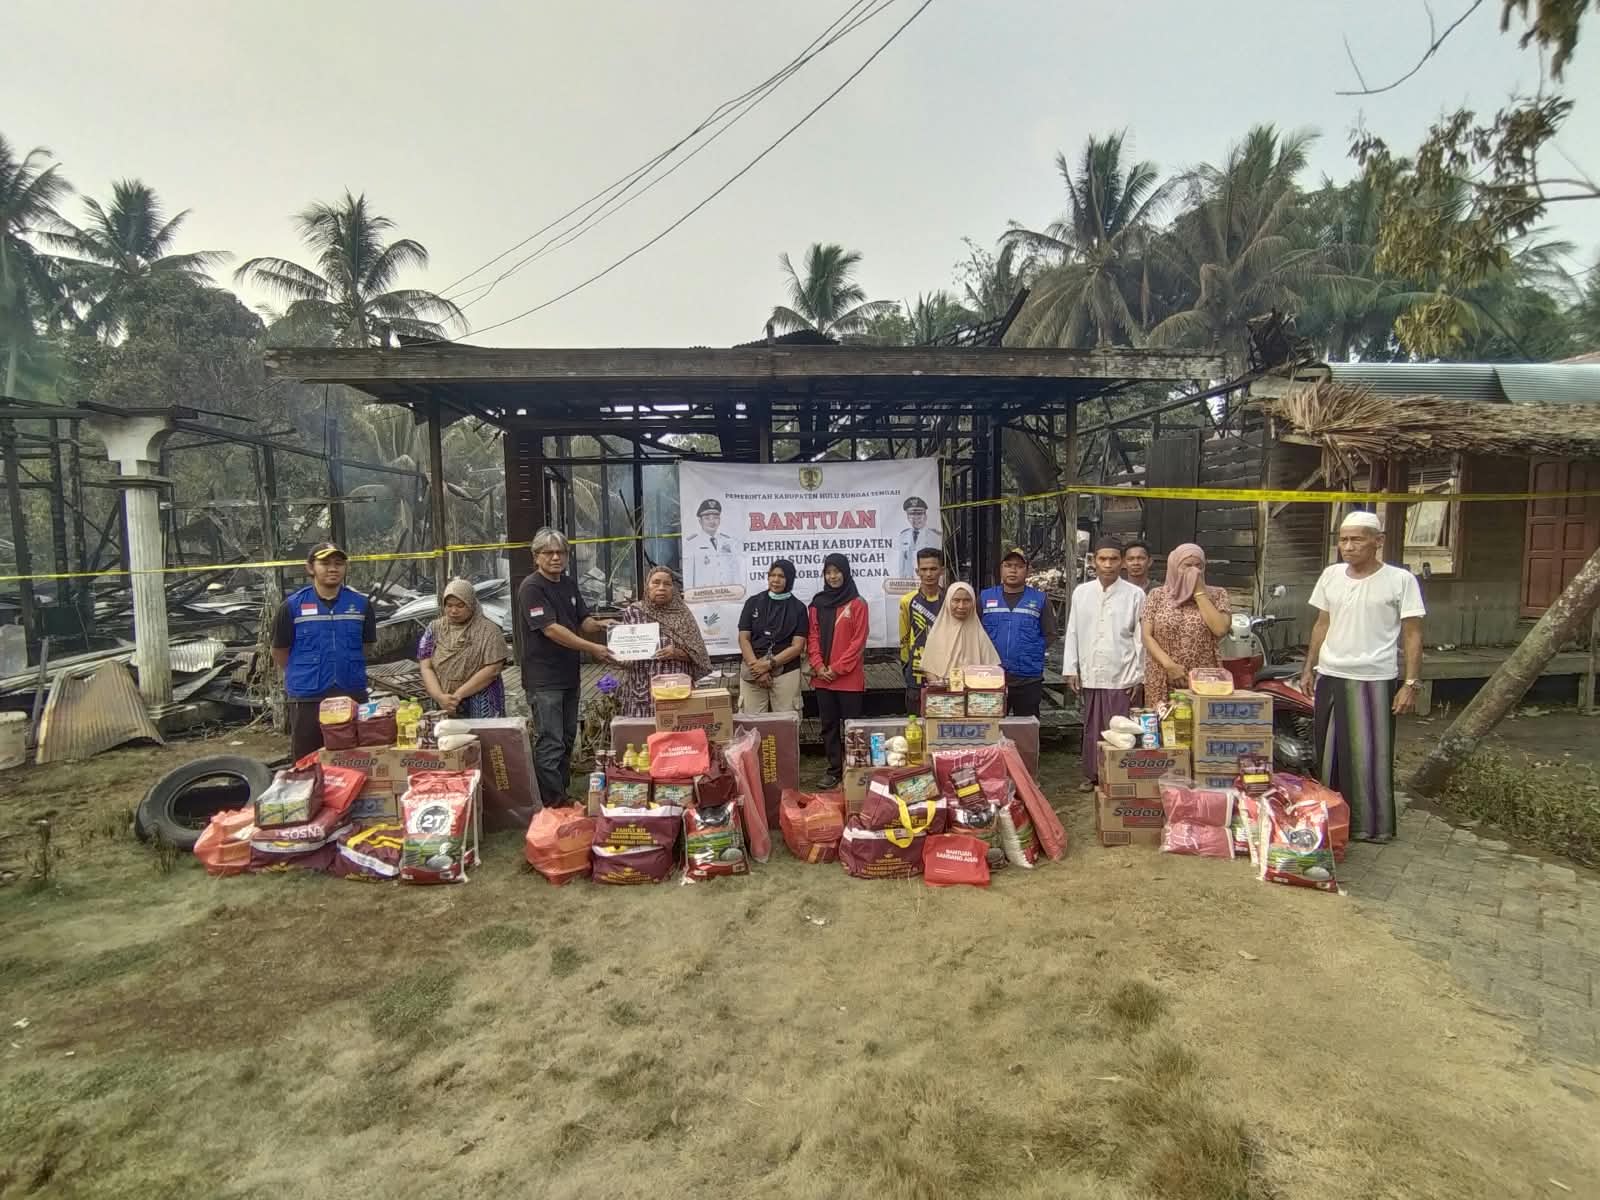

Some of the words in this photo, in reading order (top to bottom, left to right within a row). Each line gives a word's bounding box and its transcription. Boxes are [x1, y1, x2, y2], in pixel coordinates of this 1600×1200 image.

[725, 492, 773, 500] PEMERINTAH
[774, 492, 818, 500] KABUPATEN
[841, 491, 870, 499] SUNGAI
[871, 489, 901, 497] TENGAH
[749, 510, 877, 532] BANTUAN
[743, 540, 819, 552] PEMERINTAH
[822, 538, 893, 549] KABUPATEN
[788, 554, 826, 565] SUNG
[845, 552, 886, 563] ENGAH
[749, 571, 770, 581] UNT
[794, 569, 824, 579] ORB
[850, 567, 890, 577] NCANA
[1118, 758, 1176, 769] Sedaap
[1112, 807, 1164, 817] Sedaa
[421, 814, 445, 828] 2T
[945, 849, 973, 857] BANTUAN
